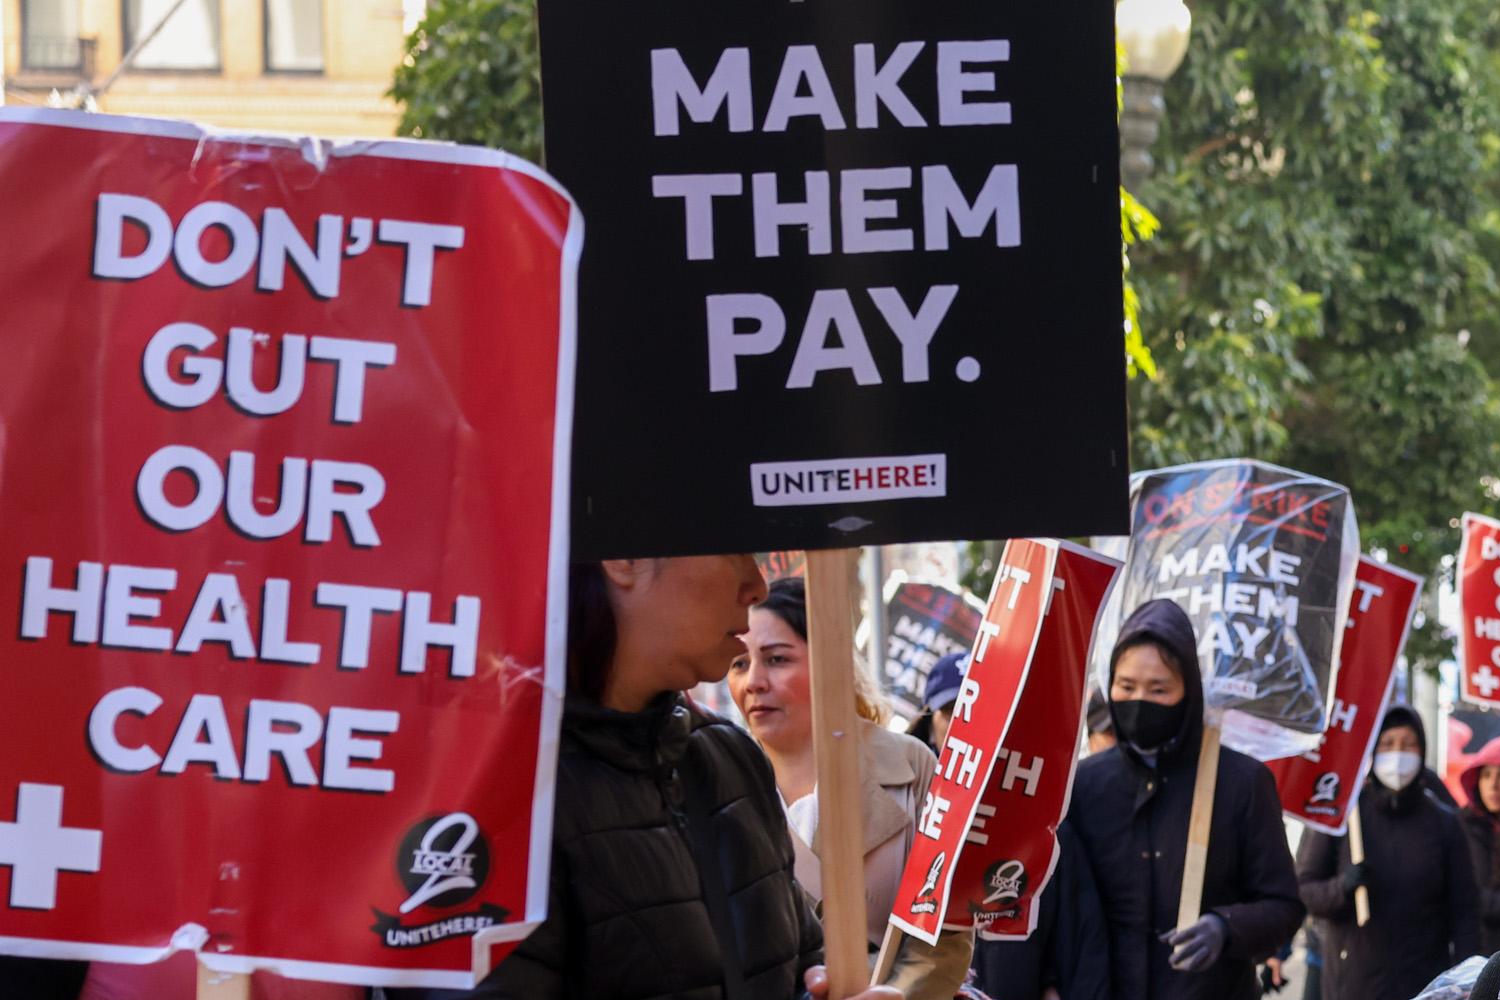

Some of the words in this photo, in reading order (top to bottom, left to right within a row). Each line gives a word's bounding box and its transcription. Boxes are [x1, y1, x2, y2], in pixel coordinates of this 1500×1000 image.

[650, 39, 1012, 137] MAKE
[651, 163, 1021, 260] THEM
[142, 322, 397, 424] GUT
[706, 284, 981, 392] PAY.
[137, 444, 386, 547] OUR
[1158, 543, 1301, 586] MAKE
[19, 556, 481, 678] HEALTH
[1197, 620, 1275, 666] AY.
[87, 686, 400, 793] CARE
[409, 850, 476, 876] LOCAL
